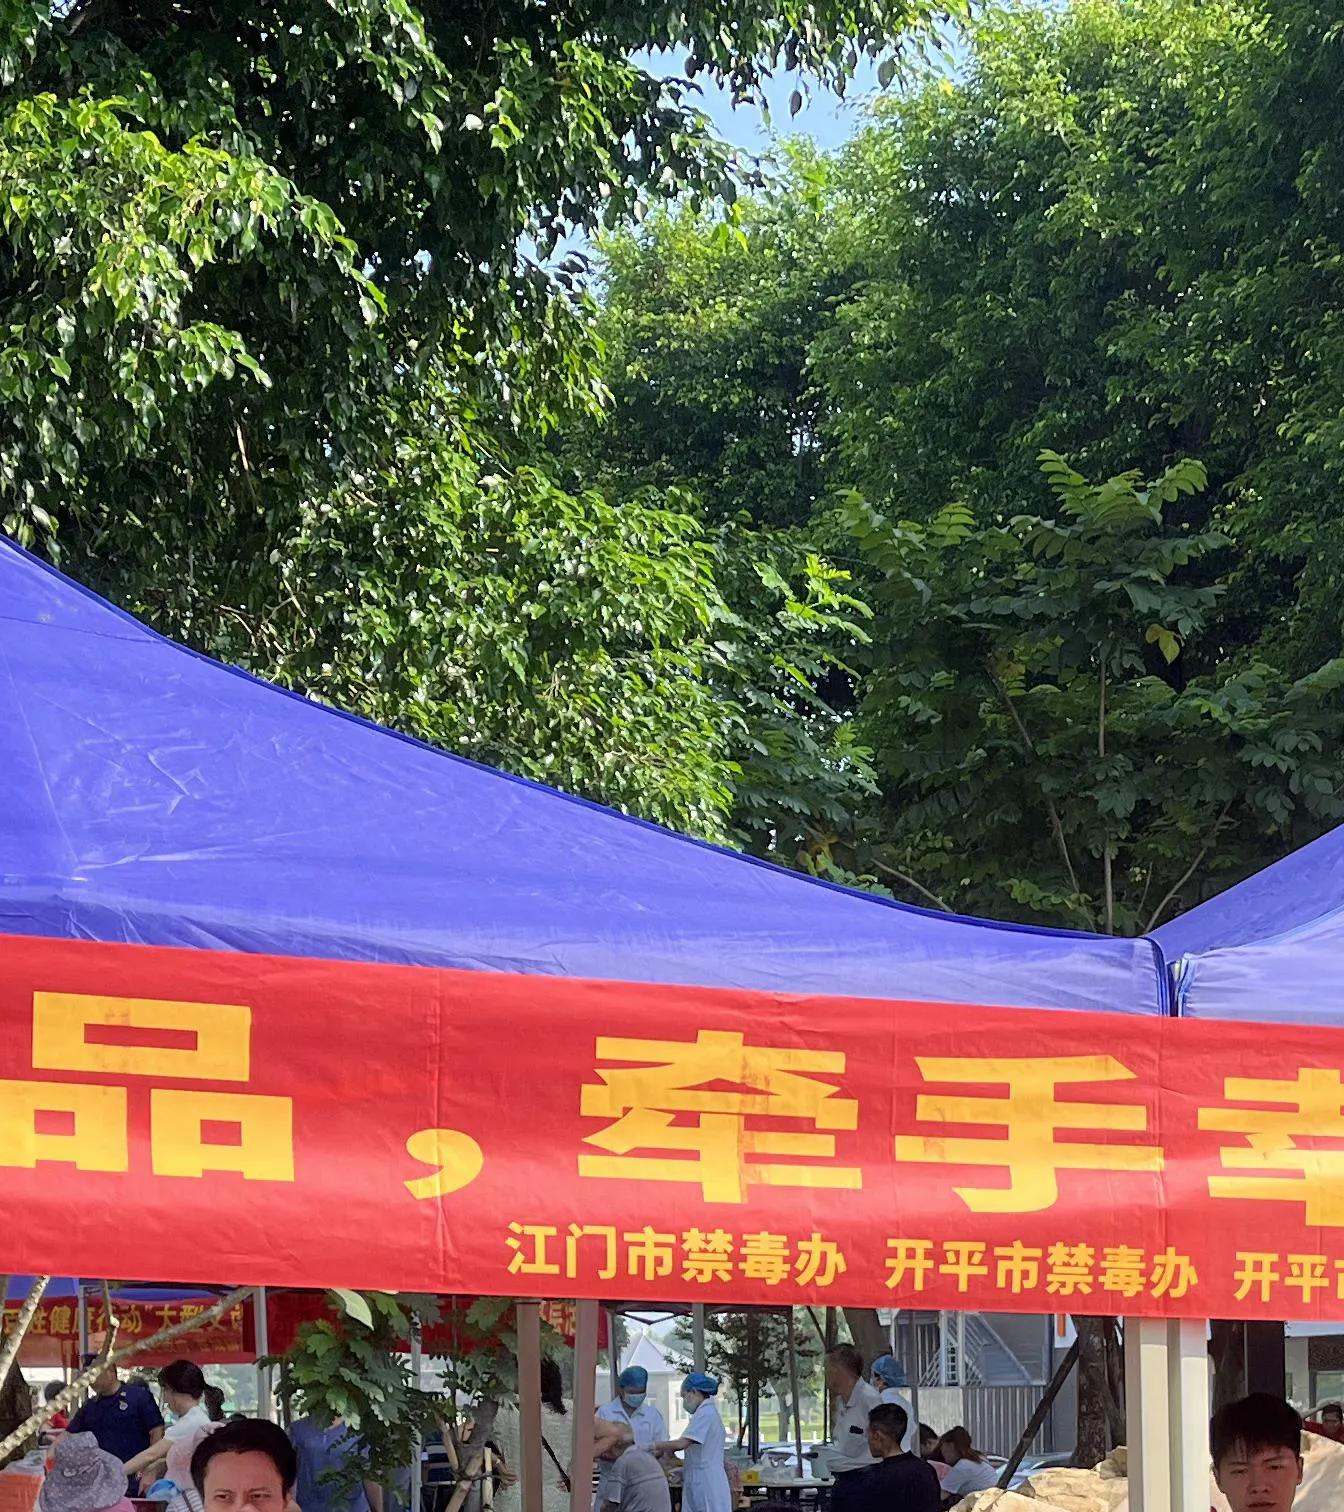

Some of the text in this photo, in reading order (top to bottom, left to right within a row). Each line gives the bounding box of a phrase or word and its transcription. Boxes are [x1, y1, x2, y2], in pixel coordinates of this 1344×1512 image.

[505, 1221, 847, 1288] 江门市禁毒办
[885, 1238, 1199, 1299] 开平市禁毒办
